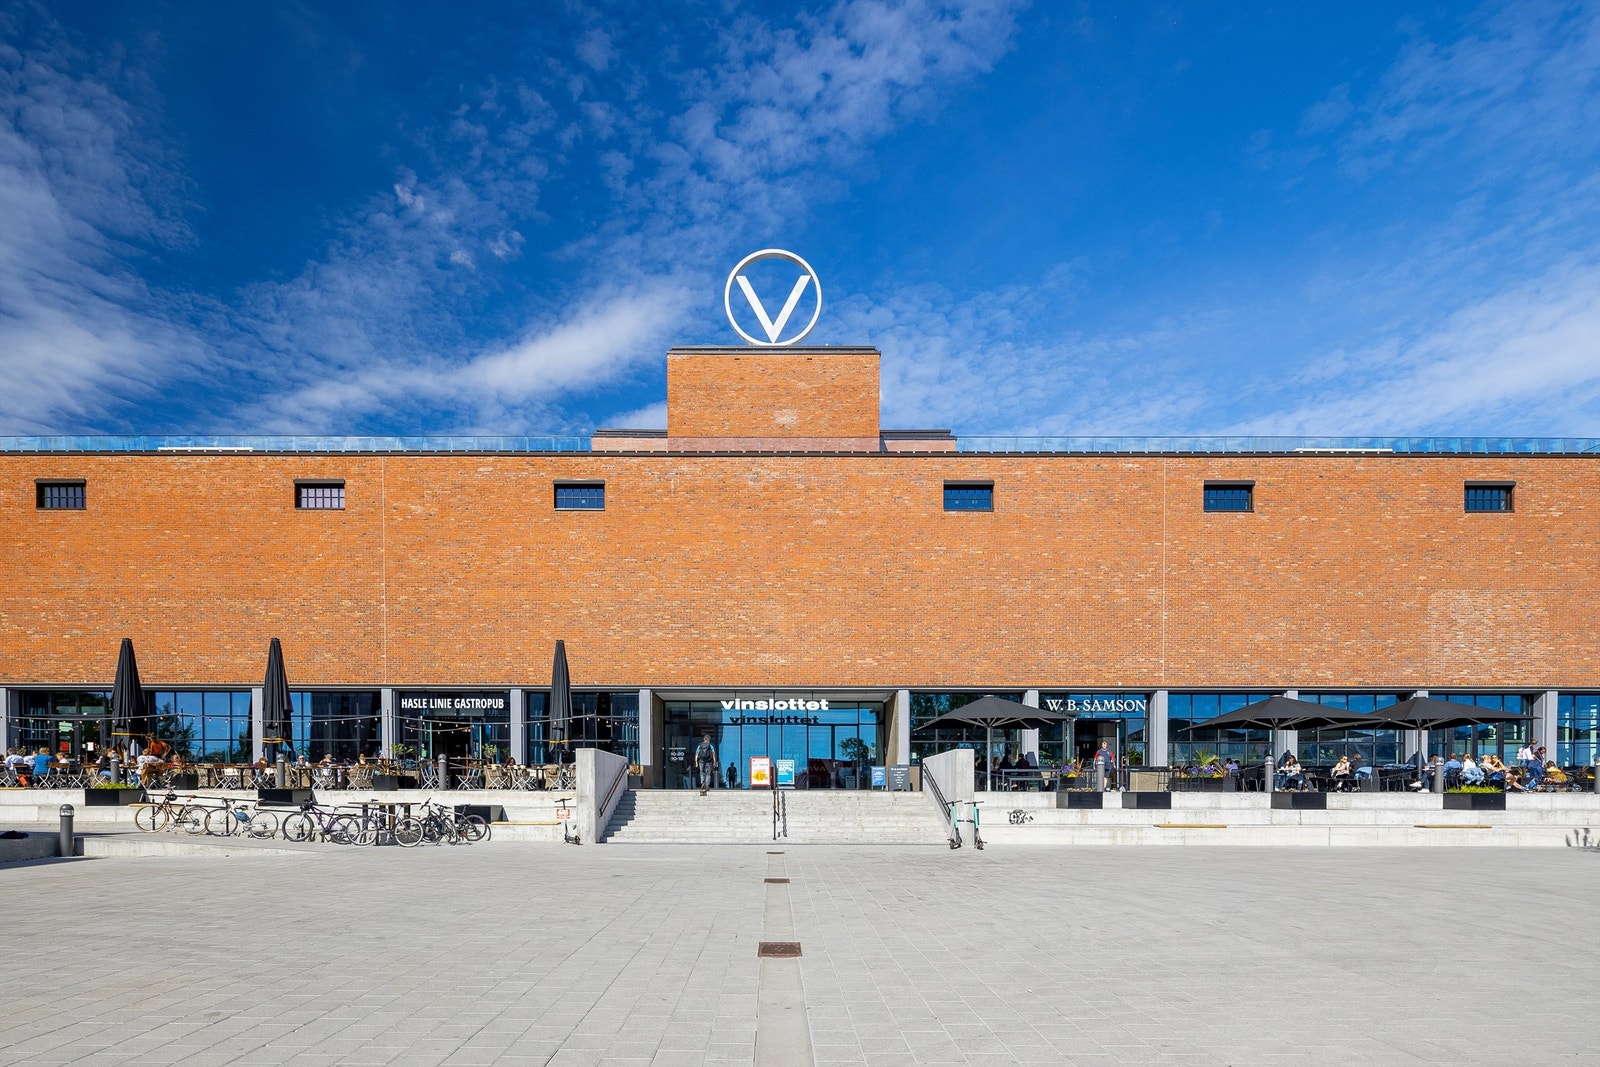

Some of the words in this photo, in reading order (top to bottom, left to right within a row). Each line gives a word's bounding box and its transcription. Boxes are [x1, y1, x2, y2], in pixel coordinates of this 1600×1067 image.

[735, 275, 811, 344] V
[402, 698, 427, 708] HASLE
[430, 698, 452, 708] LINIE
[454, 698, 504, 708] GASTROPUB
[720, 698, 828, 710] vinslottet
[1046, 700, 1063, 711] W.
[1067, 700, 1080, 710] B.
[1083, 700, 1147, 711] SAMSON
[730, 716, 819, 724] vinslottet
